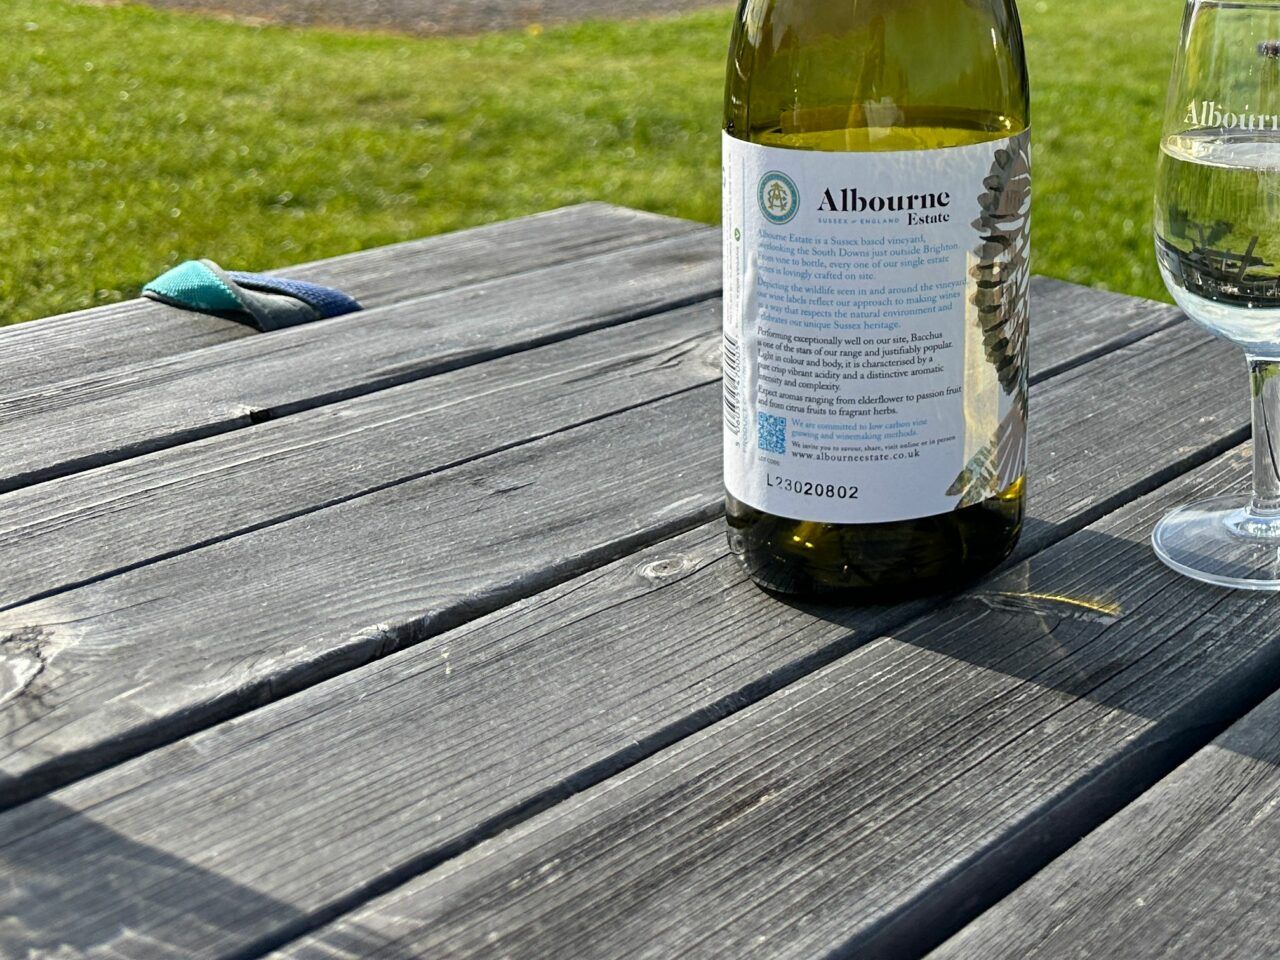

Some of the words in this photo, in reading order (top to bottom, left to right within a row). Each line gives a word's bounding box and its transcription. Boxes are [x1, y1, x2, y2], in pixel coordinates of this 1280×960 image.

[817, 187, 950, 212] Albourne
[908, 212, 950, 226] Estate
[790, 233, 812, 244] Estate
[831, 237, 858, 245] Sussex
[861, 236, 885, 245] based
[888, 235, 926, 246] vineyard,
[797, 247, 809, 255] the
[812, 247, 834, 256] South
[839, 248, 869, 257] Downs
[872, 249, 887, 258] just
[890, 246, 920, 256] outside
[758, 251, 774, 262] From
[802, 259, 827, 269] bottle,
[829, 262, 851, 270] every
[901, 258, 924, 268] single
[927, 256, 949, 264] estate
[783, 267, 812, 280] lovingly
[814, 272, 842, 280] crafted
[758, 277, 789, 293] Depicting
[791, 283, 803, 292] the
[805, 286, 834, 295] wildlife
[870, 286, 885, 295] and
[888, 284, 917, 294] around
[921, 283, 933, 291] the
[786, 294, 806, 304] labels
[809, 297, 833, 306] reflect
[853, 297, 892, 309] approach
[906, 294, 936, 304] making
[770, 305, 782, 313] way
[785, 306, 798, 314] that
[801, 310, 832, 319] respects
[835, 310, 847, 318] the
[851, 310, 880, 318] natural
[883, 306, 937, 317] environment
[938, 303, 952, 311] and
[804, 321, 831, 330] unique
[834, 321, 860, 329] Sussex
[864, 321, 901, 331] heritage.
[758, 326, 792, 343] Performing
[794, 336, 842, 347] exceptionally
[844, 337, 860, 345] well
[876, 337, 891, 345] our
[911, 331, 942, 342] Bacchus
[758, 348, 773, 361] Light
[783, 356, 804, 366] colour
[806, 359, 820, 367] and
[823, 360, 843, 369] body,
[862, 356, 915, 368] characterised
[918, 356, 926, 365] by
[814, 346, 823, 356] of
[840, 350, 862, 359] range
[865, 348, 880, 356] and
[881, 345, 920, 358] justifiably
[758, 362, 769, 373] pure
[772, 365, 786, 376] crisp
[788, 367, 812, 377] vibrant
[815, 369, 839, 381] acidity
[867, 369, 908, 379] distinctive
[911, 364, 944, 376] aromatic
[784, 378, 796, 387] and
[758, 384, 777, 397] Expect
[779, 391, 803, 401] aromas
[805, 397, 834, 406] ranging
[836, 395, 856, 405] from
[858, 395, 904, 405] elderflower
[916, 391, 944, 402] passion
[946, 386, 962, 395] fruit
[758, 398, 767, 406] and
[770, 399, 784, 409] from
[786, 405, 805, 413] citrus
[807, 405, 826, 415] fruits
[839, 407, 871, 418] fragrant
[874, 406, 898, 415] herbs.
[792, 418, 803, 427] We
[817, 421, 857, 430] committed
[885, 421, 910, 429] carbon
[792, 431, 818, 440] growing
[836, 432, 881, 441] winemaking
[900, 441, 920, 449] online
[937, 436, 956, 445] person
[791, 449, 920, 462] www.albourneestate.co.uk
[766, 472, 859, 499] L23020802
